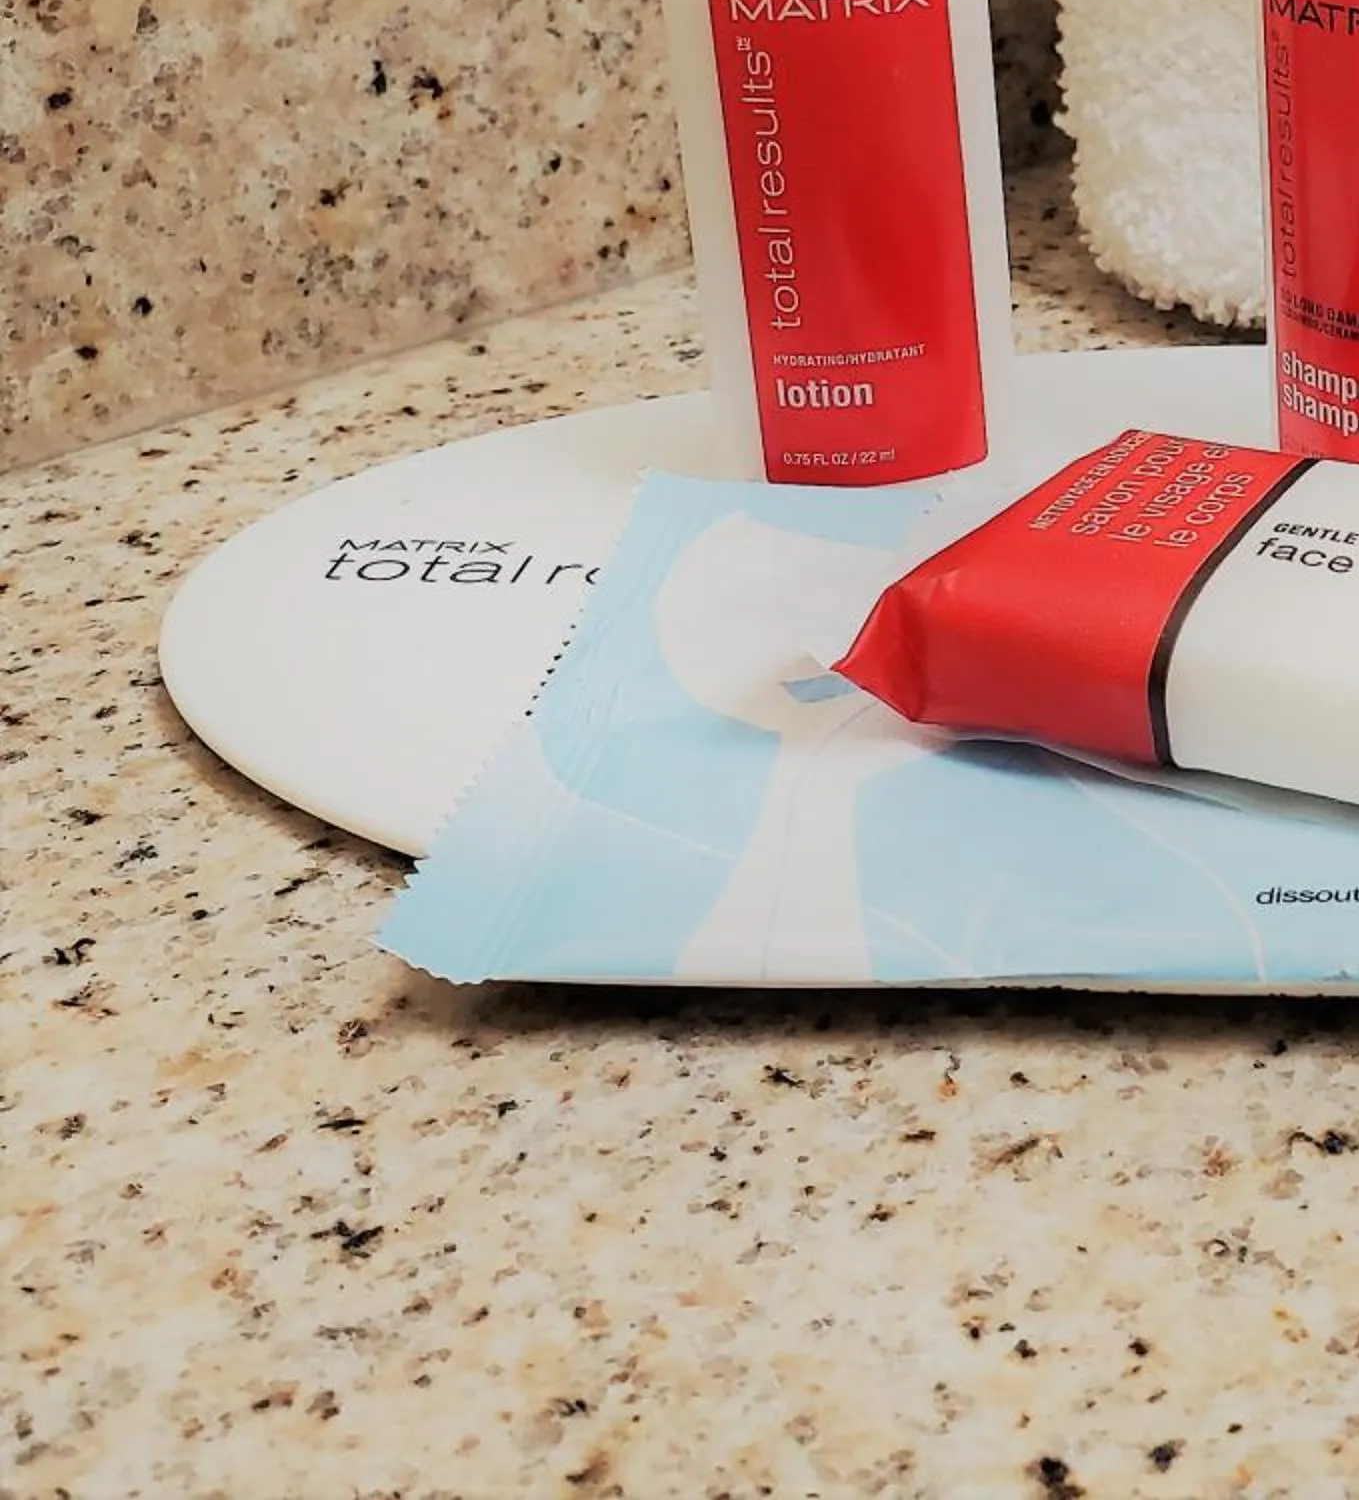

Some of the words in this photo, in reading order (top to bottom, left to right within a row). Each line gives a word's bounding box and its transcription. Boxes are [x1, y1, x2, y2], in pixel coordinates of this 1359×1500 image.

[773, 343, 926, 367] HYDRATING/HYDRATANT
[776, 378, 873, 408] lotion
[813, 453, 829, 466] FL
[831, 452, 849, 466] OZ
[859, 451, 877, 464] 22
[1072, 477, 1146, 535] savon
[1105, 524, 1152, 543] le
[1139, 462, 1215, 519] visage
[1153, 528, 1199, 548] le
[1186, 472, 1253, 526] corps
[339, 538, 516, 554] MATRIX
[1272, 522, 1359, 545] GENTLE
[324, 552, 534, 584] total
[1255, 537, 1354, 573] face
